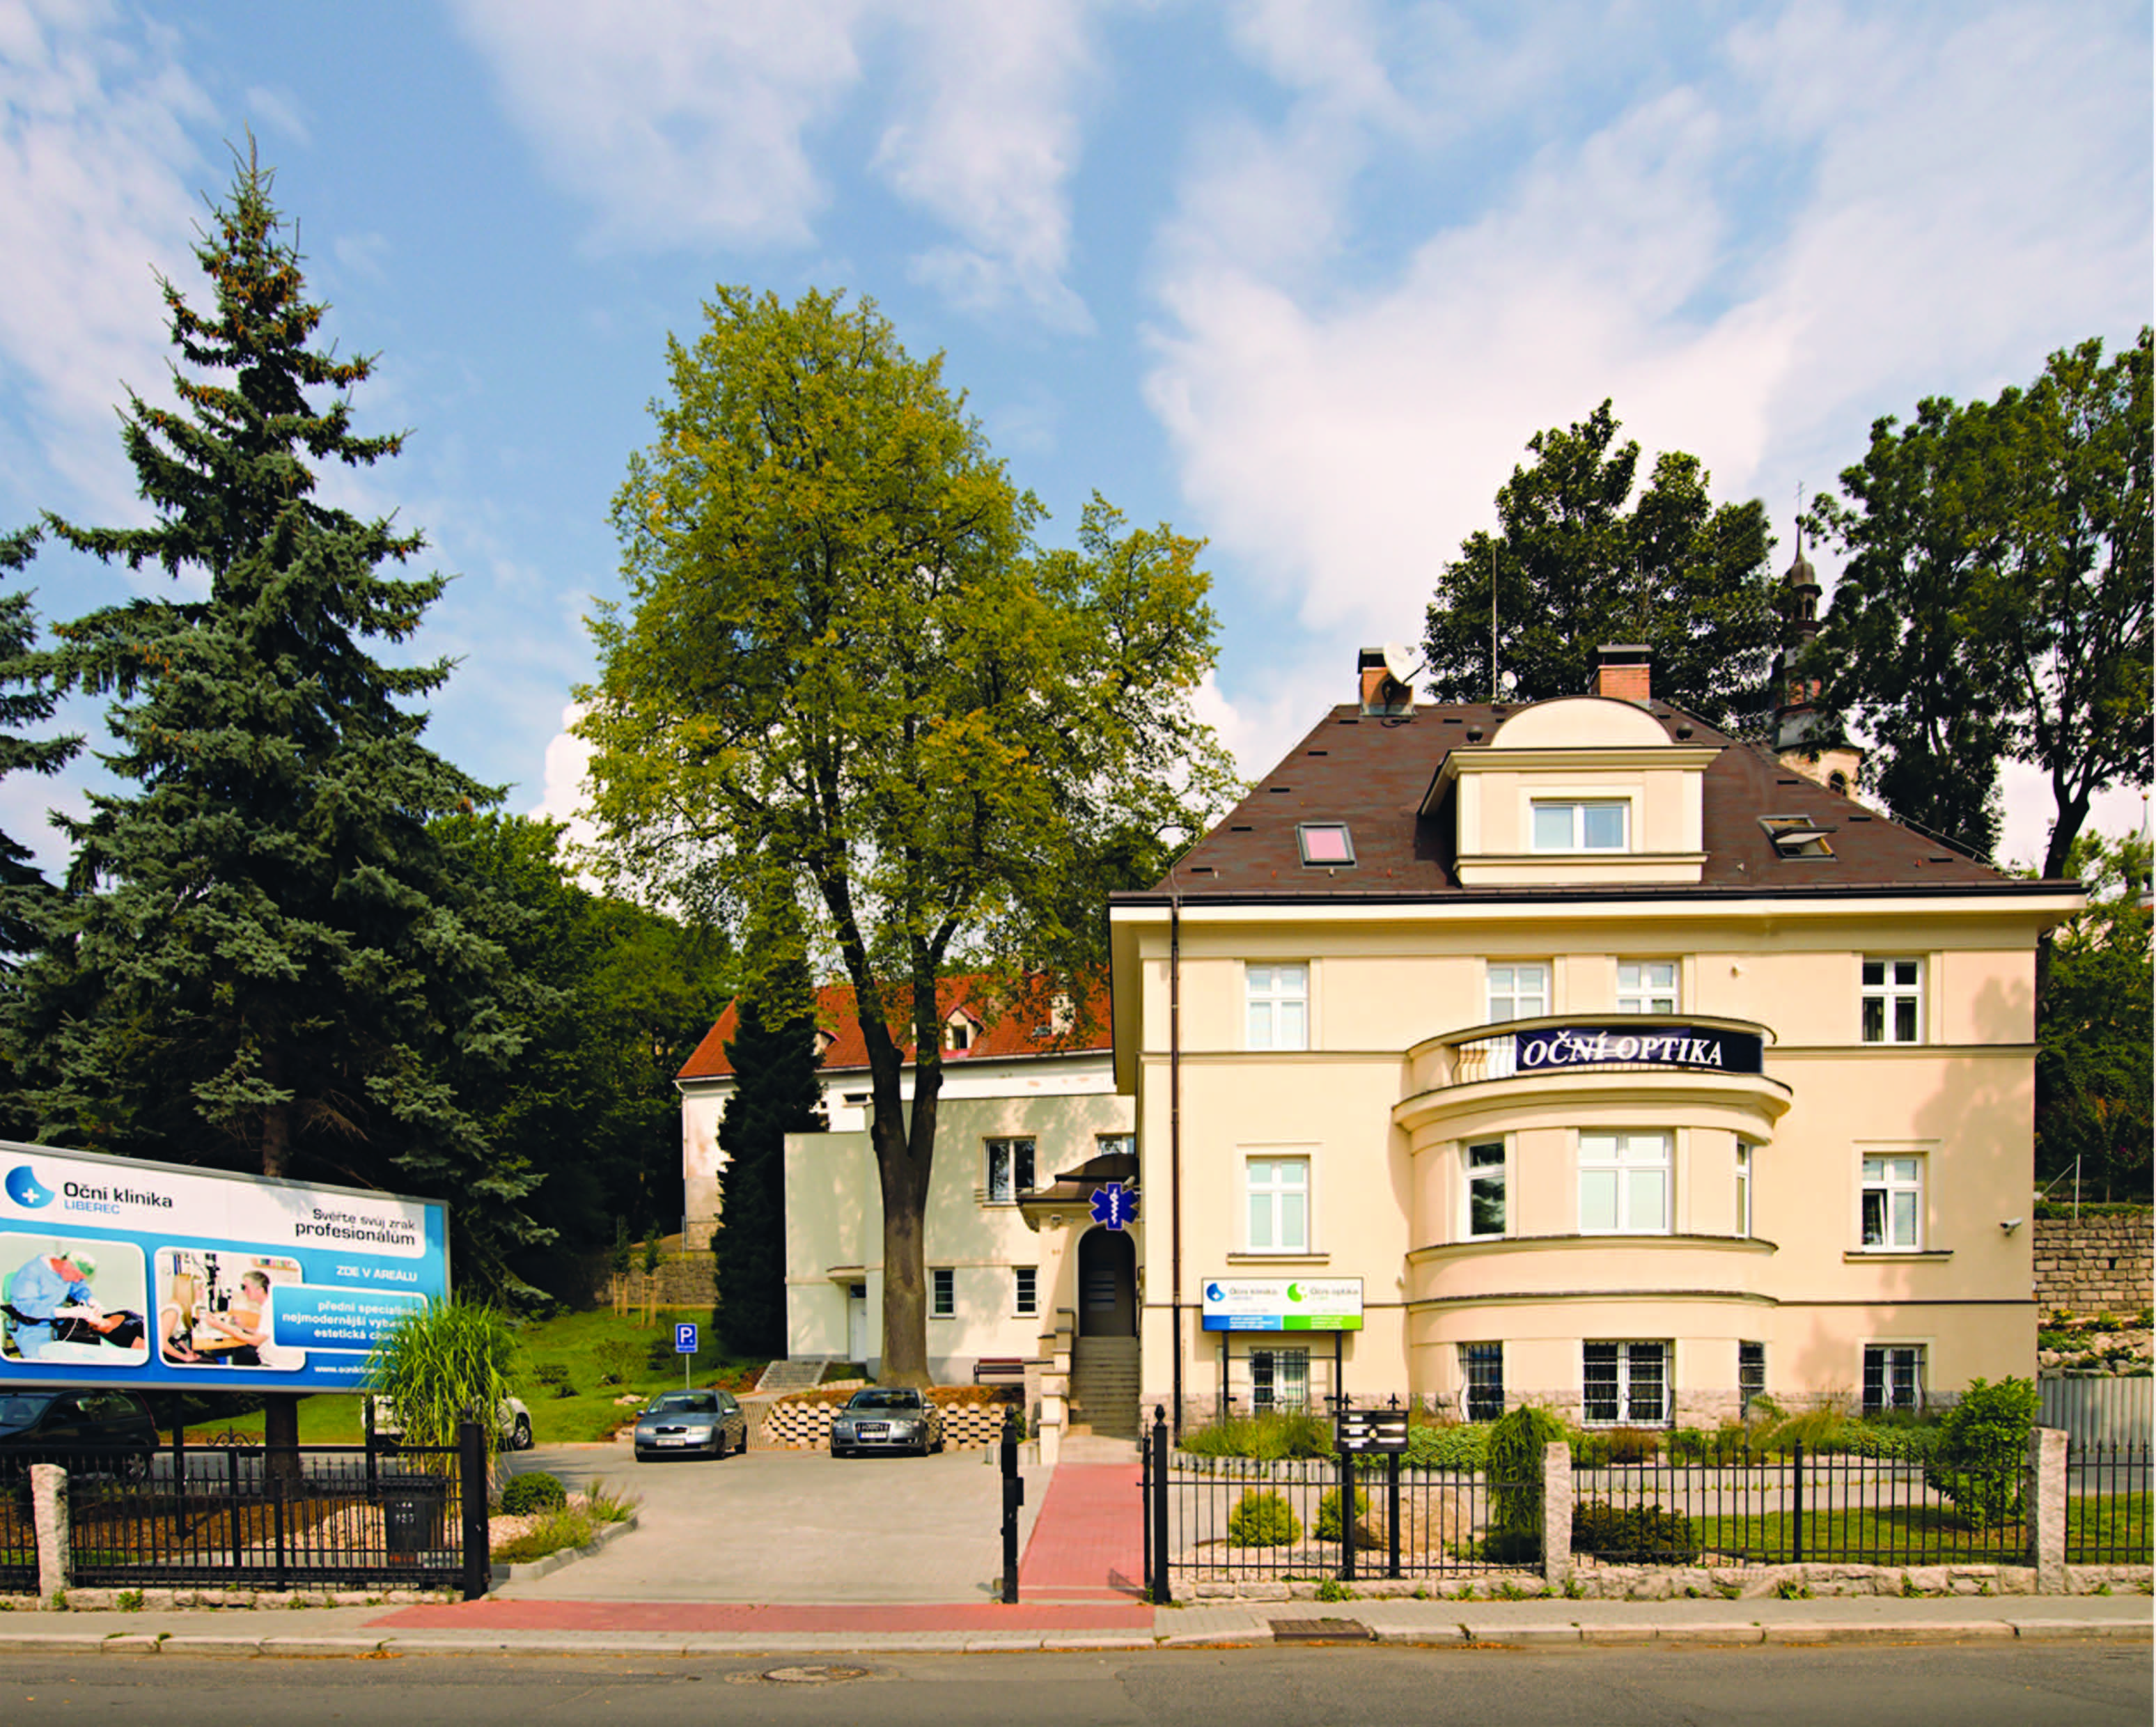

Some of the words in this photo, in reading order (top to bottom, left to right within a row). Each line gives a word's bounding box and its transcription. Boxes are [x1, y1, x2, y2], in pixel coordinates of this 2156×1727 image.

[1523, 1031, 1607, 1066] OČNÍ
[1615, 1036, 1722, 1066] OPTIKA
[63, 1182, 107, 1200] Oční
[114, 1187, 173, 1208] klinika
[64, 1199, 120, 1214] LIBEREC
[389, 1219, 415, 1230] zrak
[336, 1265, 359, 1276] ZDE
[362, 1268, 371, 1278] V
[373, 1267, 418, 1282] AREÁLU
[318, 1300, 356, 1313] přední
[314, 1328, 366, 1340] estetická
[680, 1327, 693, 1343] P
